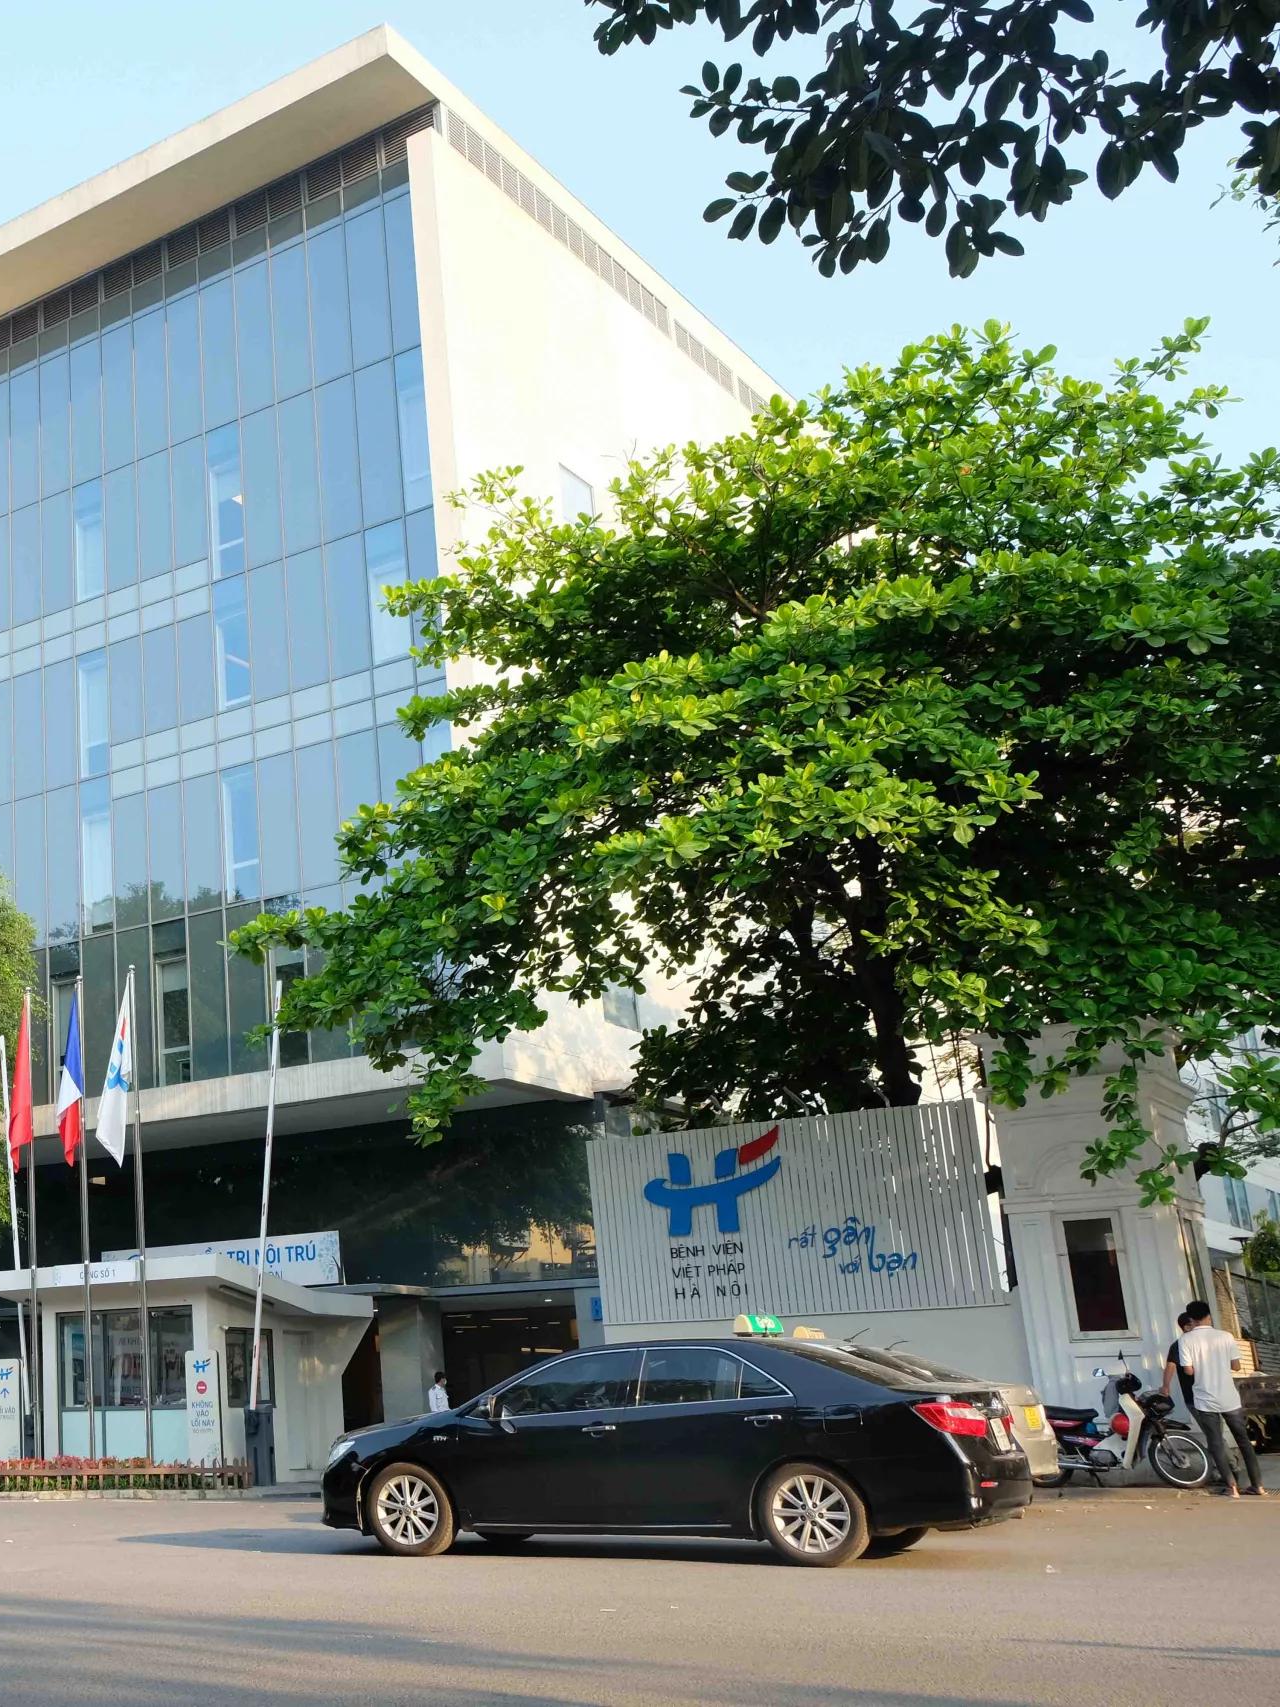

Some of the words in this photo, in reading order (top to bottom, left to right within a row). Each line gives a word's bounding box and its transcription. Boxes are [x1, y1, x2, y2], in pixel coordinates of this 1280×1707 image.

[788, 1224, 817, 1249] rất
[823, 1216, 871, 1259] gần
[285, 1240, 316, 1262] TRÚ
[670, 1244, 705, 1260] BỆNH
[712, 1240, 744, 1257] VIỆN
[839, 1255, 862, 1274] với
[868, 1225, 918, 1277] bạn
[80, 1269, 99, 1280] CNG
[672, 1263, 702, 1281] VIỆT
[708, 1259, 745, 1276] PHÁP
[675, 1283, 701, 1299] HÀ
[716, 1281, 748, 1299] NỘI
